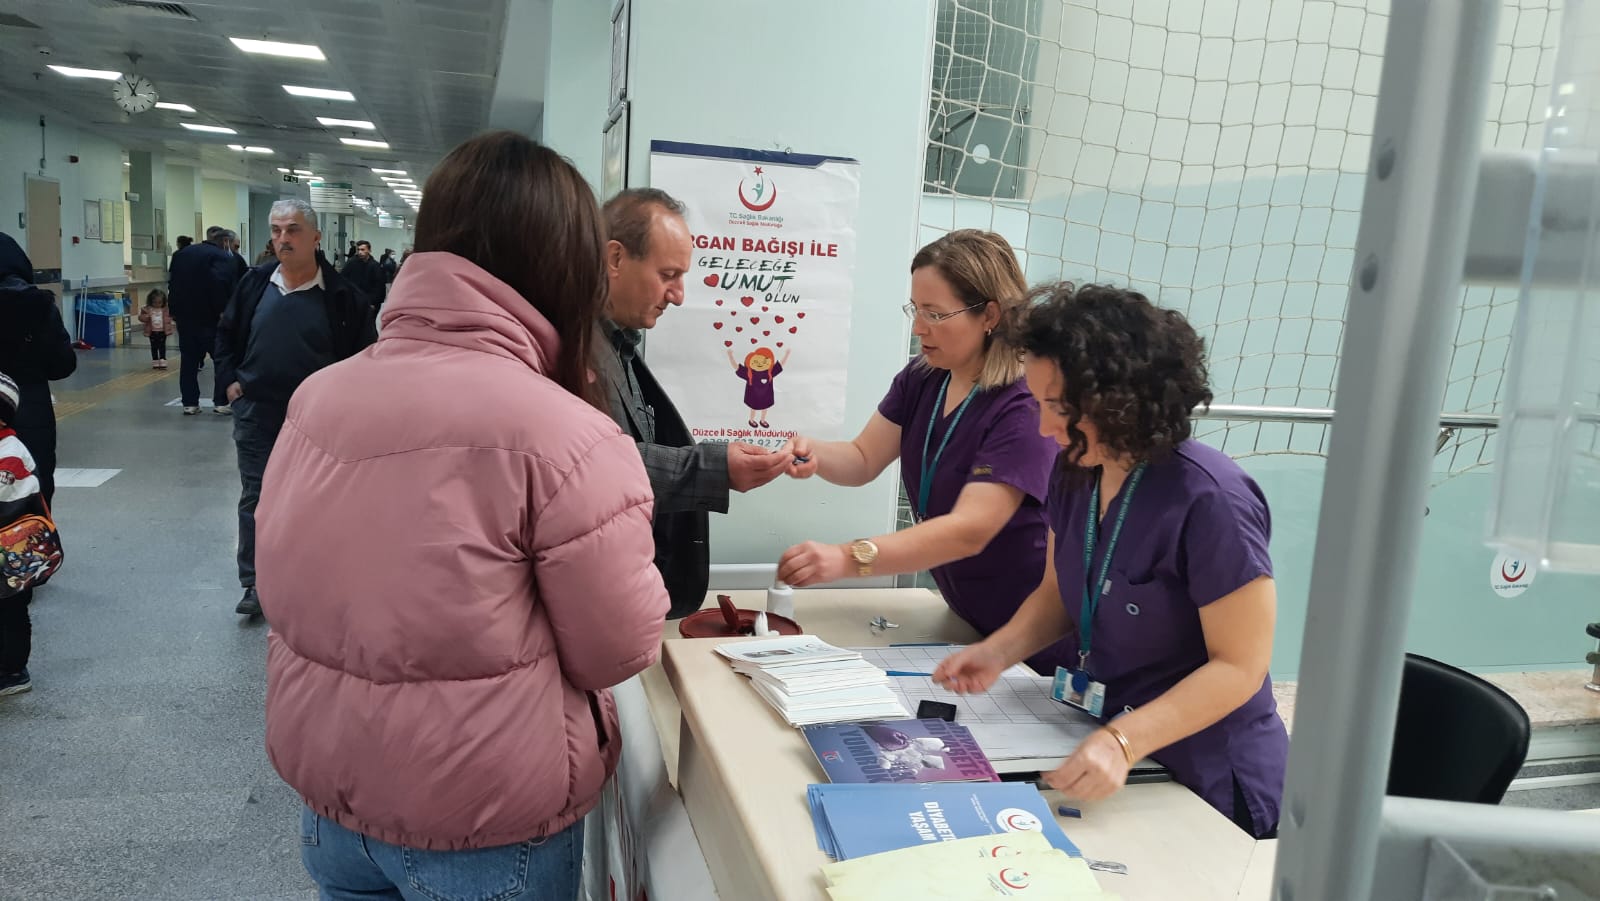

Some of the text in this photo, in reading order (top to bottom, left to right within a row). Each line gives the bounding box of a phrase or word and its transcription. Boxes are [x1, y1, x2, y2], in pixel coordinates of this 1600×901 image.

[742, 237, 804, 259] BAĞIŞI
[810, 239, 838, 258] İLE
[698, 256, 797, 273] GELECEĞE
[720, 272, 795, 293] UMUT
[764, 292, 801, 304] OLUN
[692, 428, 719, 437] Düzce
[726, 428, 752, 439] Sağlık
